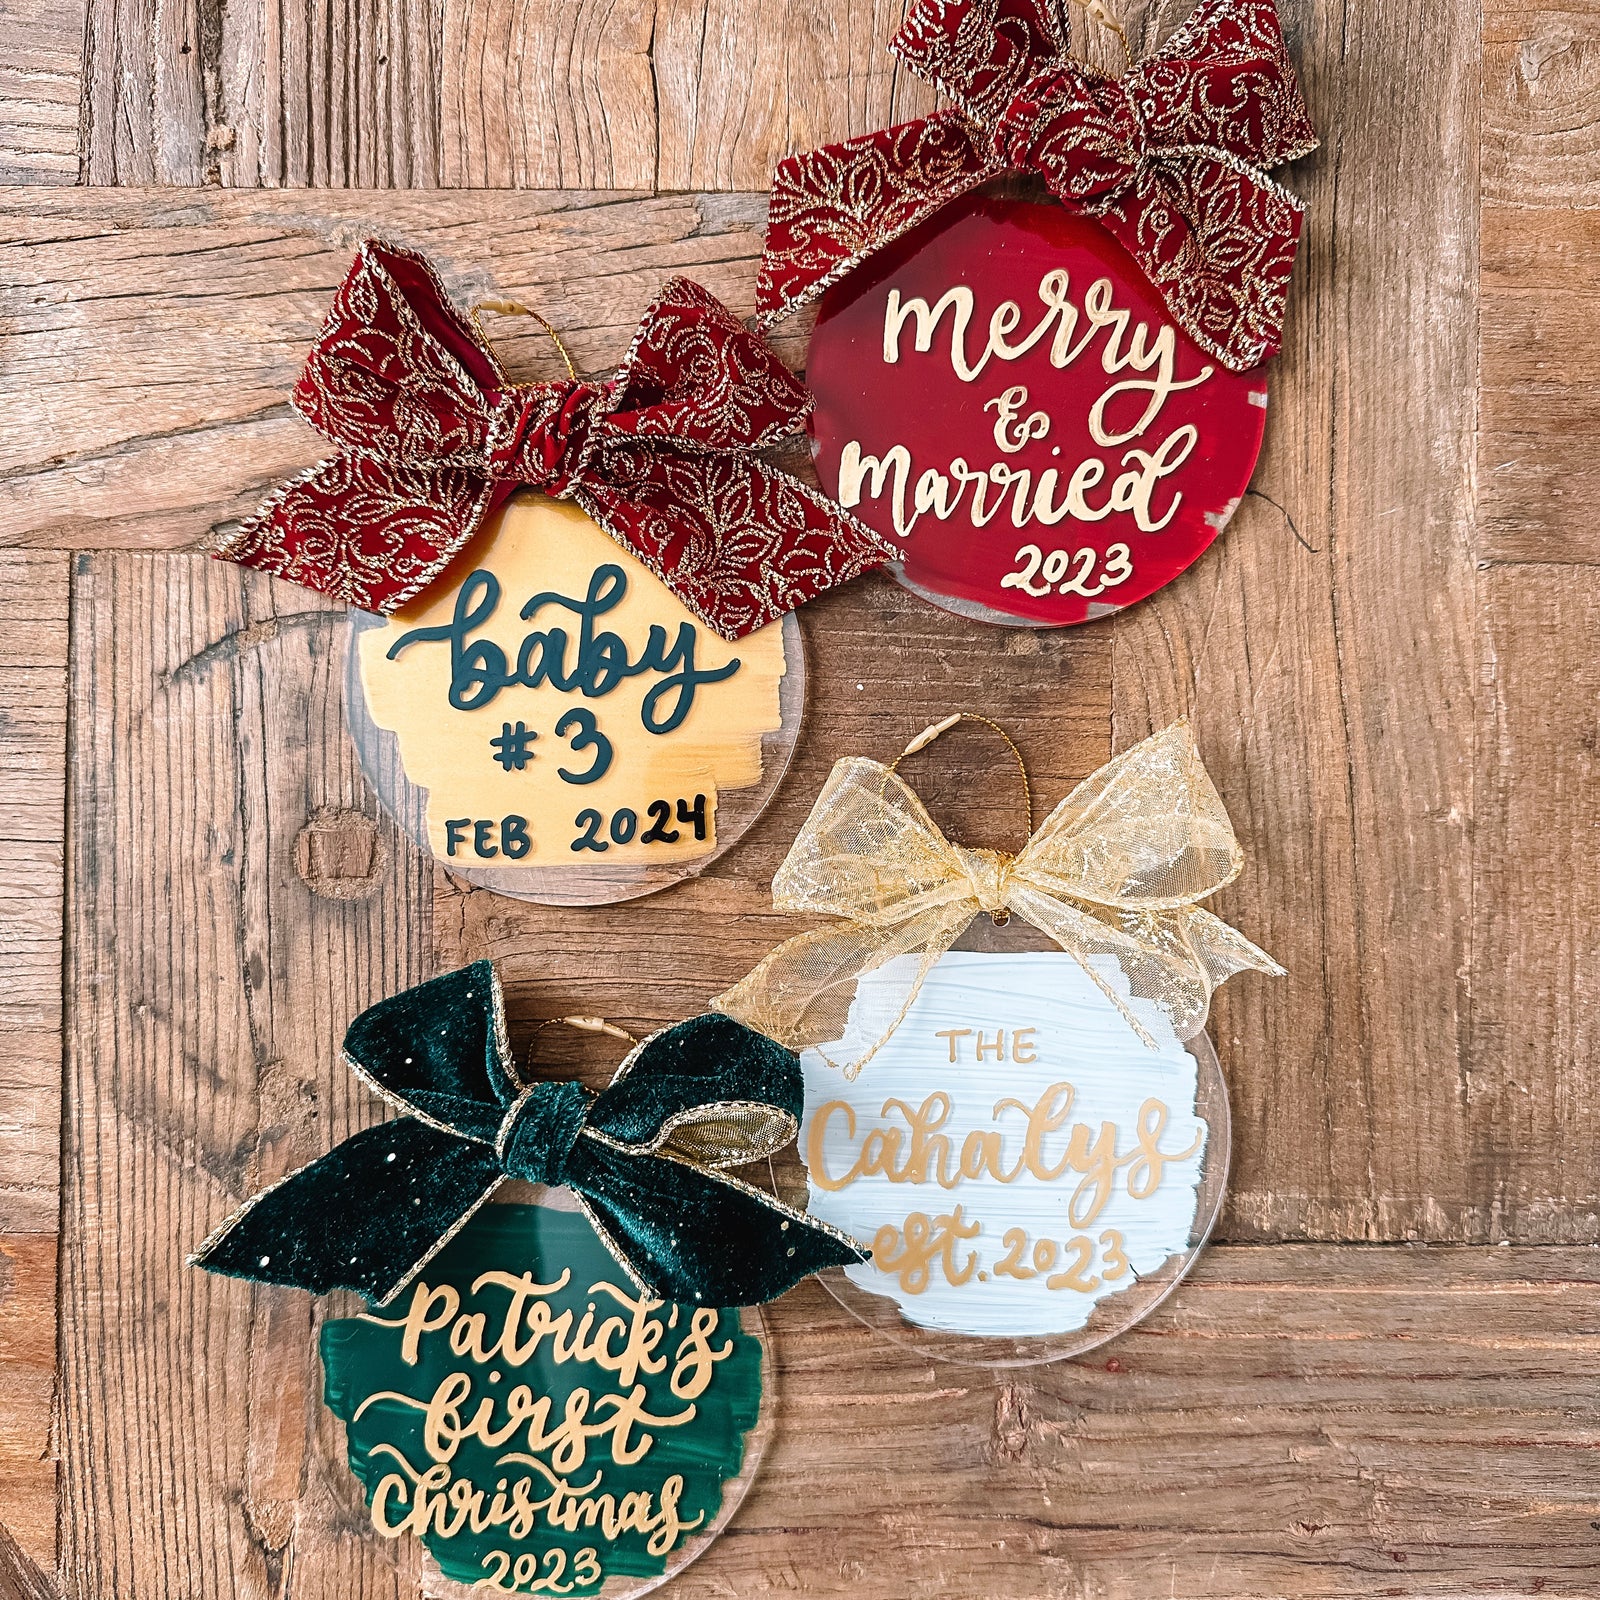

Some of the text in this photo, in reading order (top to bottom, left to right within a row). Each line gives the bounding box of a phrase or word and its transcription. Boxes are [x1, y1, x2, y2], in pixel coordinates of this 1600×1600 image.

[984, 386, 1050, 453] &
[838, 423, 1198, 537] Married
[1000, 542, 1133, 597] 2023
[385, 563, 742, 734] baby
[445, 793, 706, 860] FEB 2024
[934, 1028, 1038, 1064] THE
[806, 1081, 1203, 1229] Cahalys
[992, 1227, 1129, 1293] 2023
[356, 1267, 734, 1399] Patrick's
[353, 1370, 697, 1474] first
[367, 1443, 705, 1556] Christmas
[473, 1547, 602, 1593] 2023
